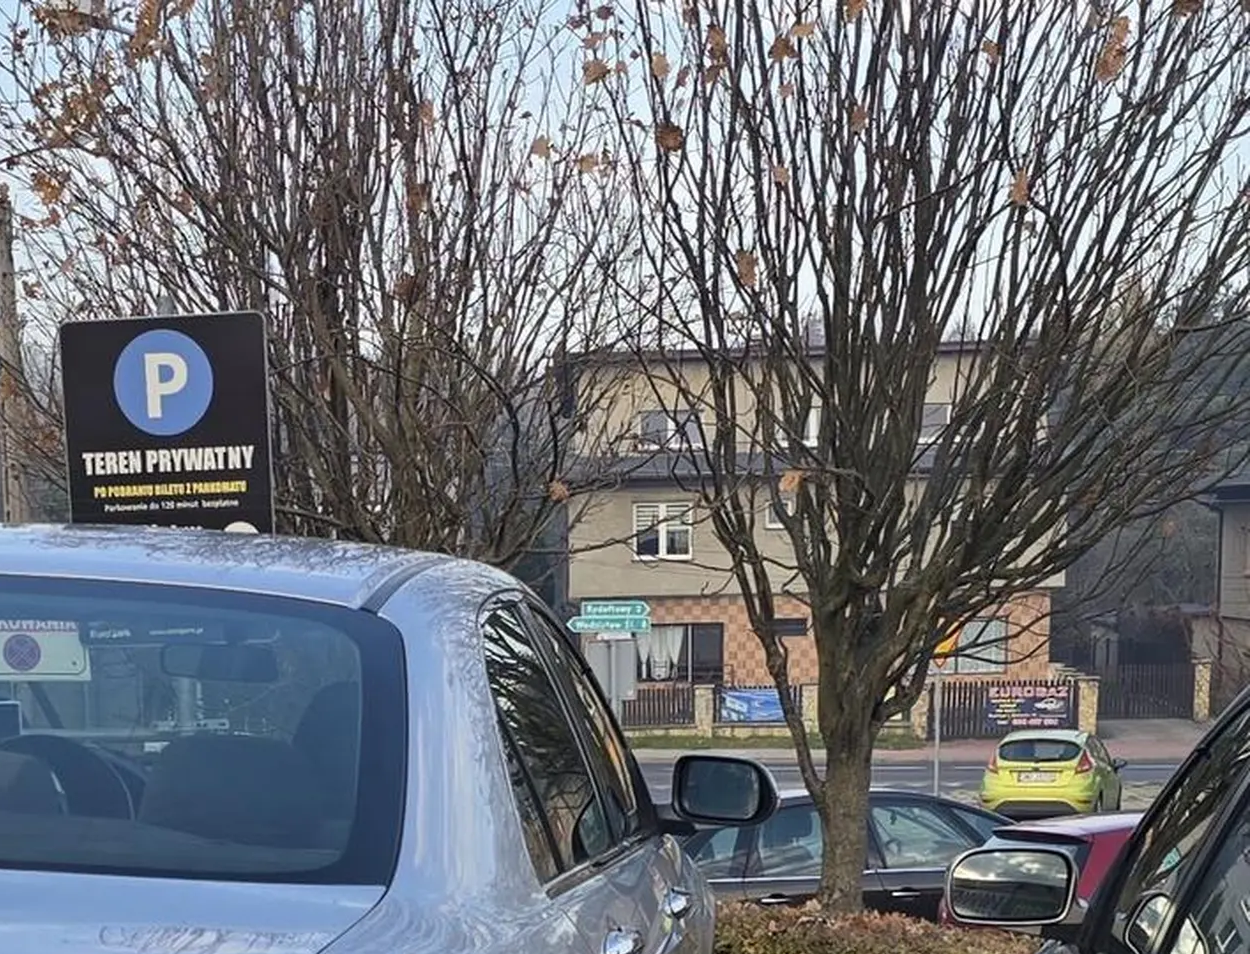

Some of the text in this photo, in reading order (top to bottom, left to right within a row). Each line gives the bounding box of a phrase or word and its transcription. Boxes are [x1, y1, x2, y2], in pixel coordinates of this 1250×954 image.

[144, 352, 188, 419] P
[82, 445, 254, 476] TEREN PRYWATNY
[94, 486, 107, 498] PO
